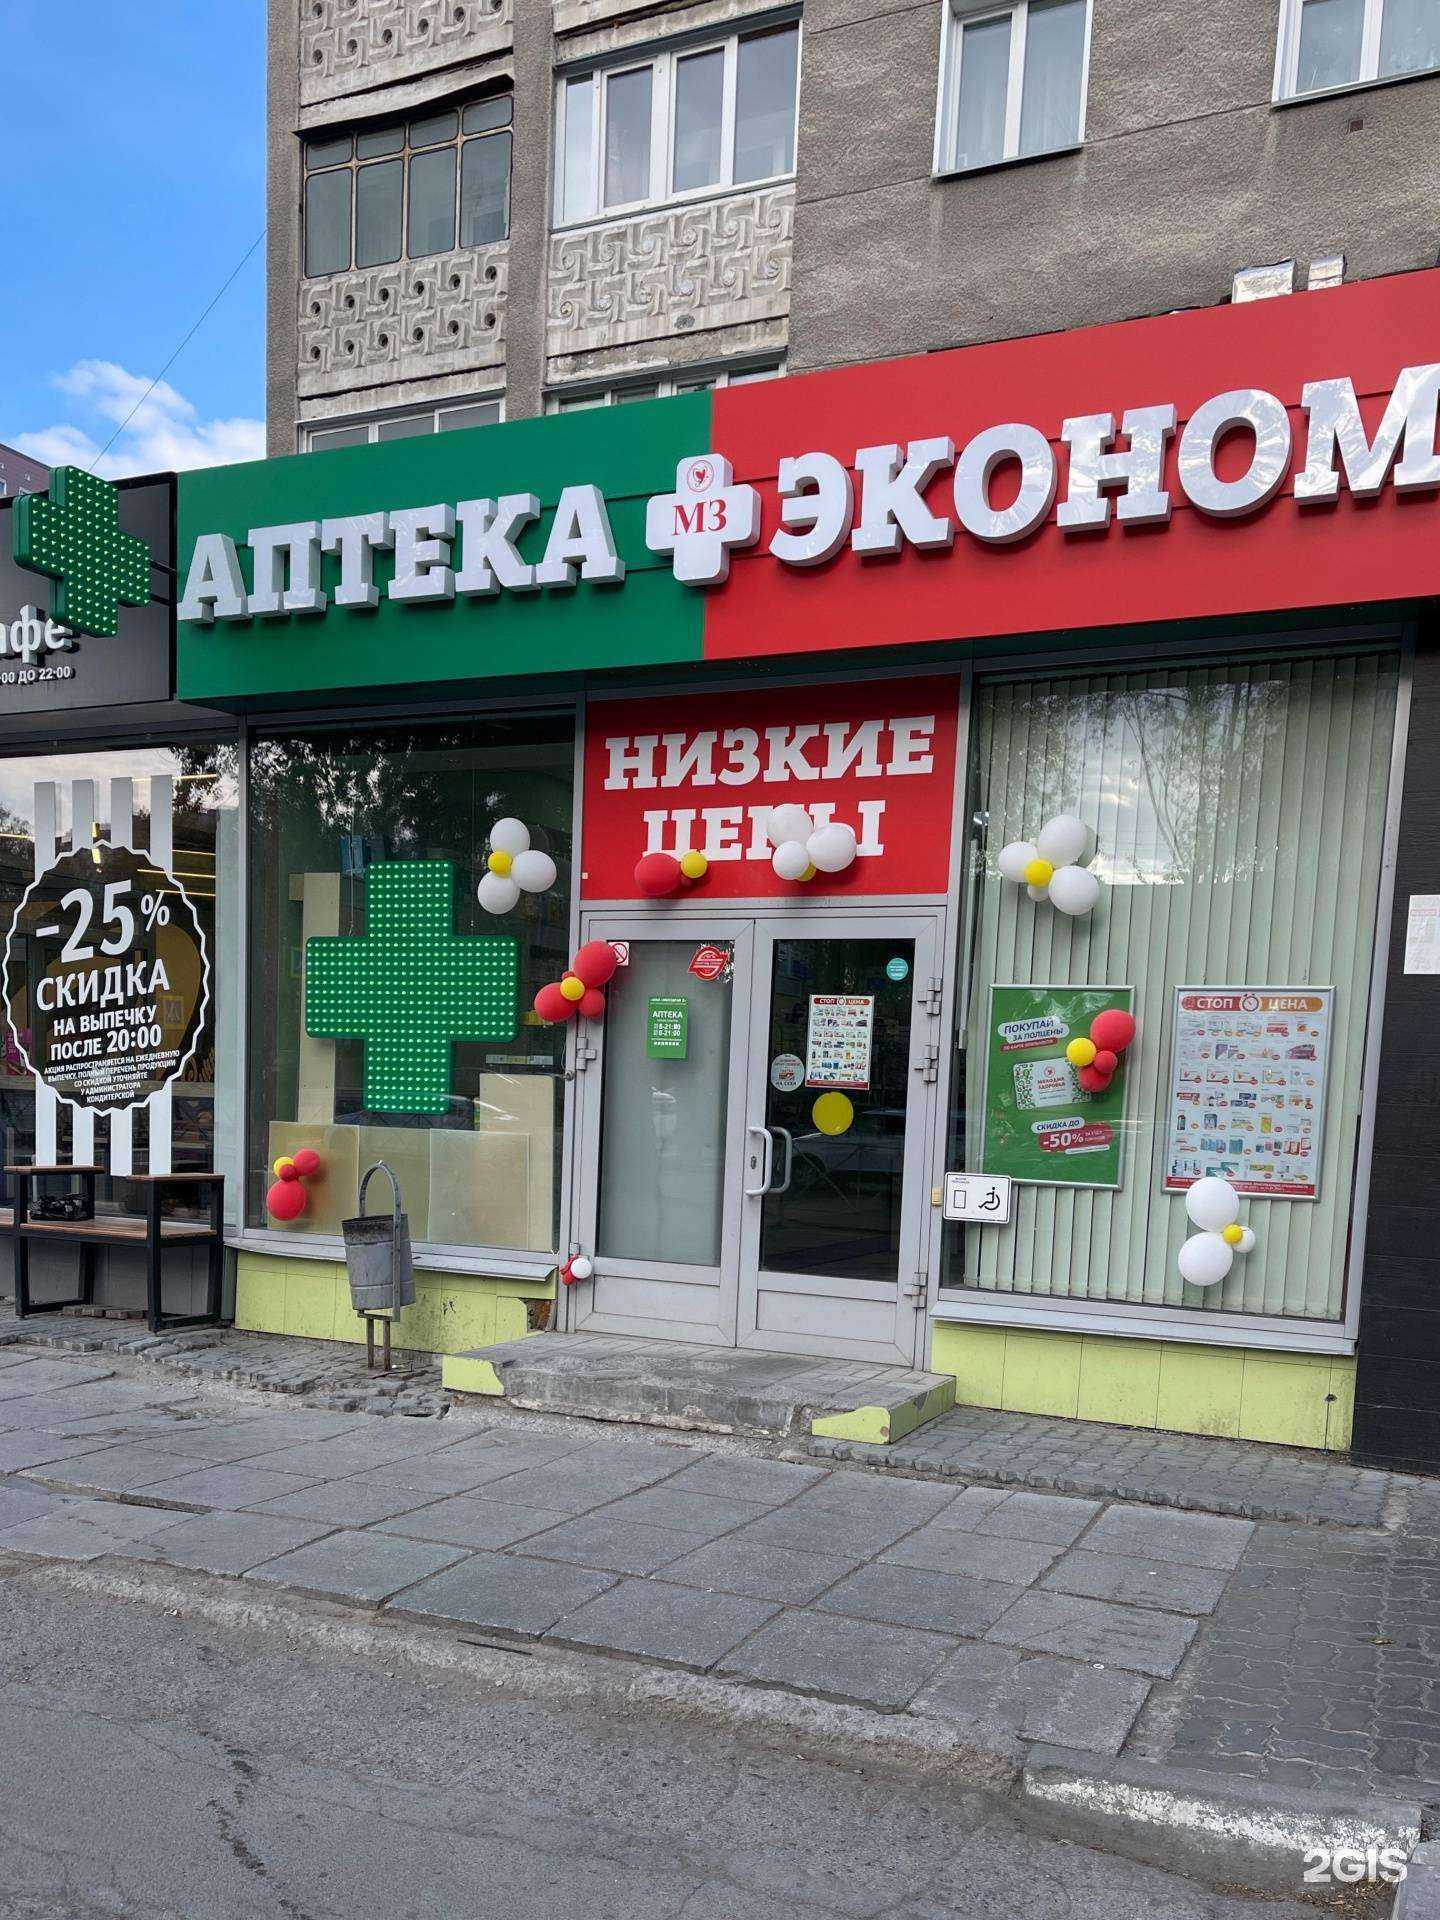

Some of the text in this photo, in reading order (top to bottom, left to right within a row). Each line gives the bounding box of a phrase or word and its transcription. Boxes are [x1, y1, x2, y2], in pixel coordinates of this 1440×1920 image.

[178, 485, 625, 623] АПТЕКА
[768, 362, 1440, 567] ЭКОНОМ
[18, 669, 36, 684] ДО
[604, 715, 935, 790] НИЗКИЕ
[36, 880, 170, 963] -25%
[37, 958, 170, 1010] СКИДКА
[1196, 999, 1308, 1010] СТОП ЦЕНА
[54, 1005, 157, 1036] НА ВЫПЕЧКУ
[652, 1010, 683, 1018] АПТЕКА
[51, 1037, 102, 1060] ПОСЛЕ
[107, 1024, 162, 1053] 20:00
[44, 1050, 180, 1074] АКЦИЯ РАСПРОСТРАНЯЕТСЯ НА ЕЖЕДНЕВНУЮ
[105, 1065, 136, 1075] ПЕРЕЧЕНЬ
[138, 1060, 176, 1070] ПРОДУКЦИИ
[83, 1077, 111, 1087] СКИДКОЙ
[113, 1071, 148, 1083] УТОЧНЯЙТЕ
[85, 1082, 141, 1095] АДМИНИСТРАТОРА
[87, 1090, 135, 1103] КОНДИТЕРСКОЙ
[1037, 1119, 1080, 1131] СКИДКА ДО
[1043, 1132, 1084, 1148] -50%
